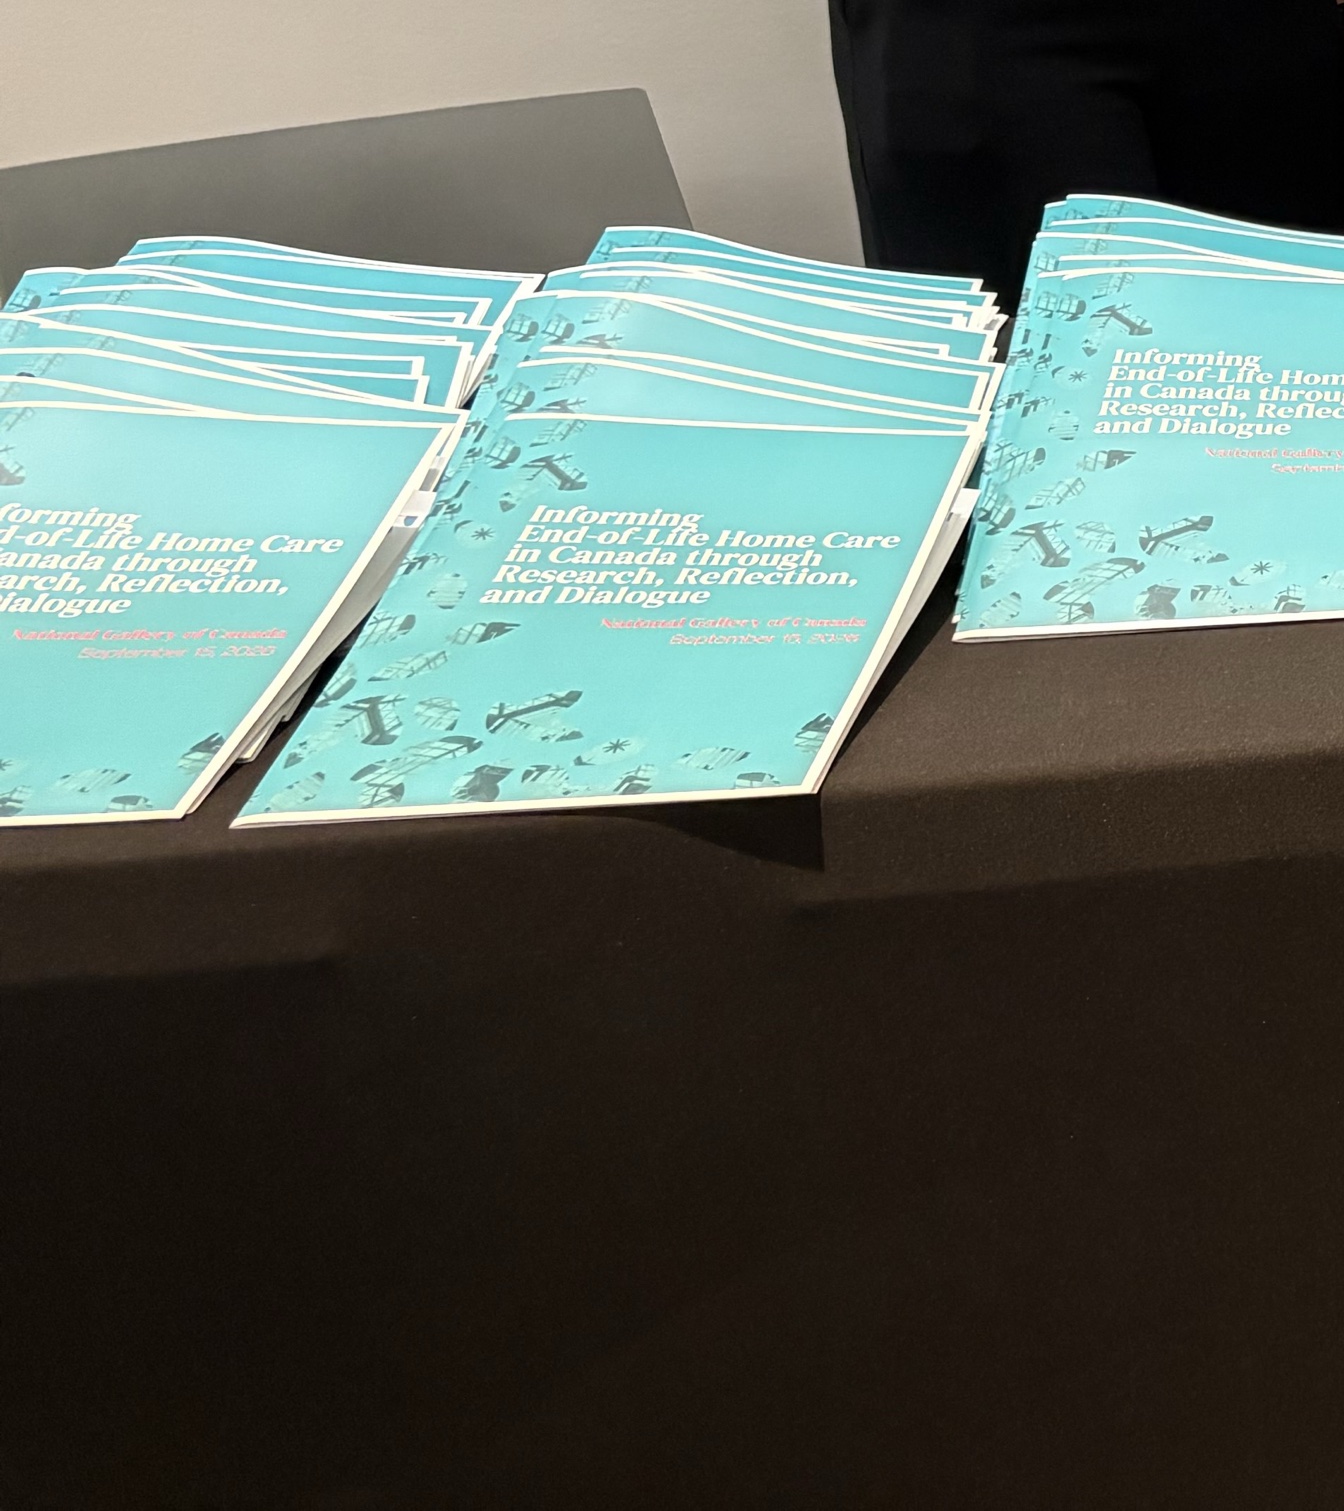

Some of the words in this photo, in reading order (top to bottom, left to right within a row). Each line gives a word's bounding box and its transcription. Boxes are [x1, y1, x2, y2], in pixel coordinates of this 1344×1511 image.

[1112, 348, 1263, 371] Informing
[1107, 365, 1274, 385] End-of-Life
[1103, 382, 1133, 399] in
[1139, 383, 1251, 401] Canada
[1097, 400, 1248, 420] Research,
[1092, 417, 1153, 434] and
[1157, 418, 1292, 440] Dialogue
[0, 502, 142, 534] forming
[529, 504, 705, 533] Informing
[0, 525, 143, 551] d-of-Life
[146, 532, 255, 553] Home
[259, 534, 345, 554] Care
[516, 524, 710, 547] End-of-Life
[714, 529, 816, 548] Home
[822, 531, 901, 549] Care
[0, 548, 103, 572] anada
[112, 552, 259, 577] through
[504, 544, 542, 563] in
[548, 545, 678, 566] Canada
[685, 548, 823, 571] through
[0, 571, 88, 595] arch,
[96, 573, 290, 596] Reflection,
[492, 564, 665, 587] Research,
[674, 567, 858, 588] Reflection,
[0, 591, 132, 618] ialogue
[479, 585, 555, 604] and
[554, 586, 711, 609] Dialogue
